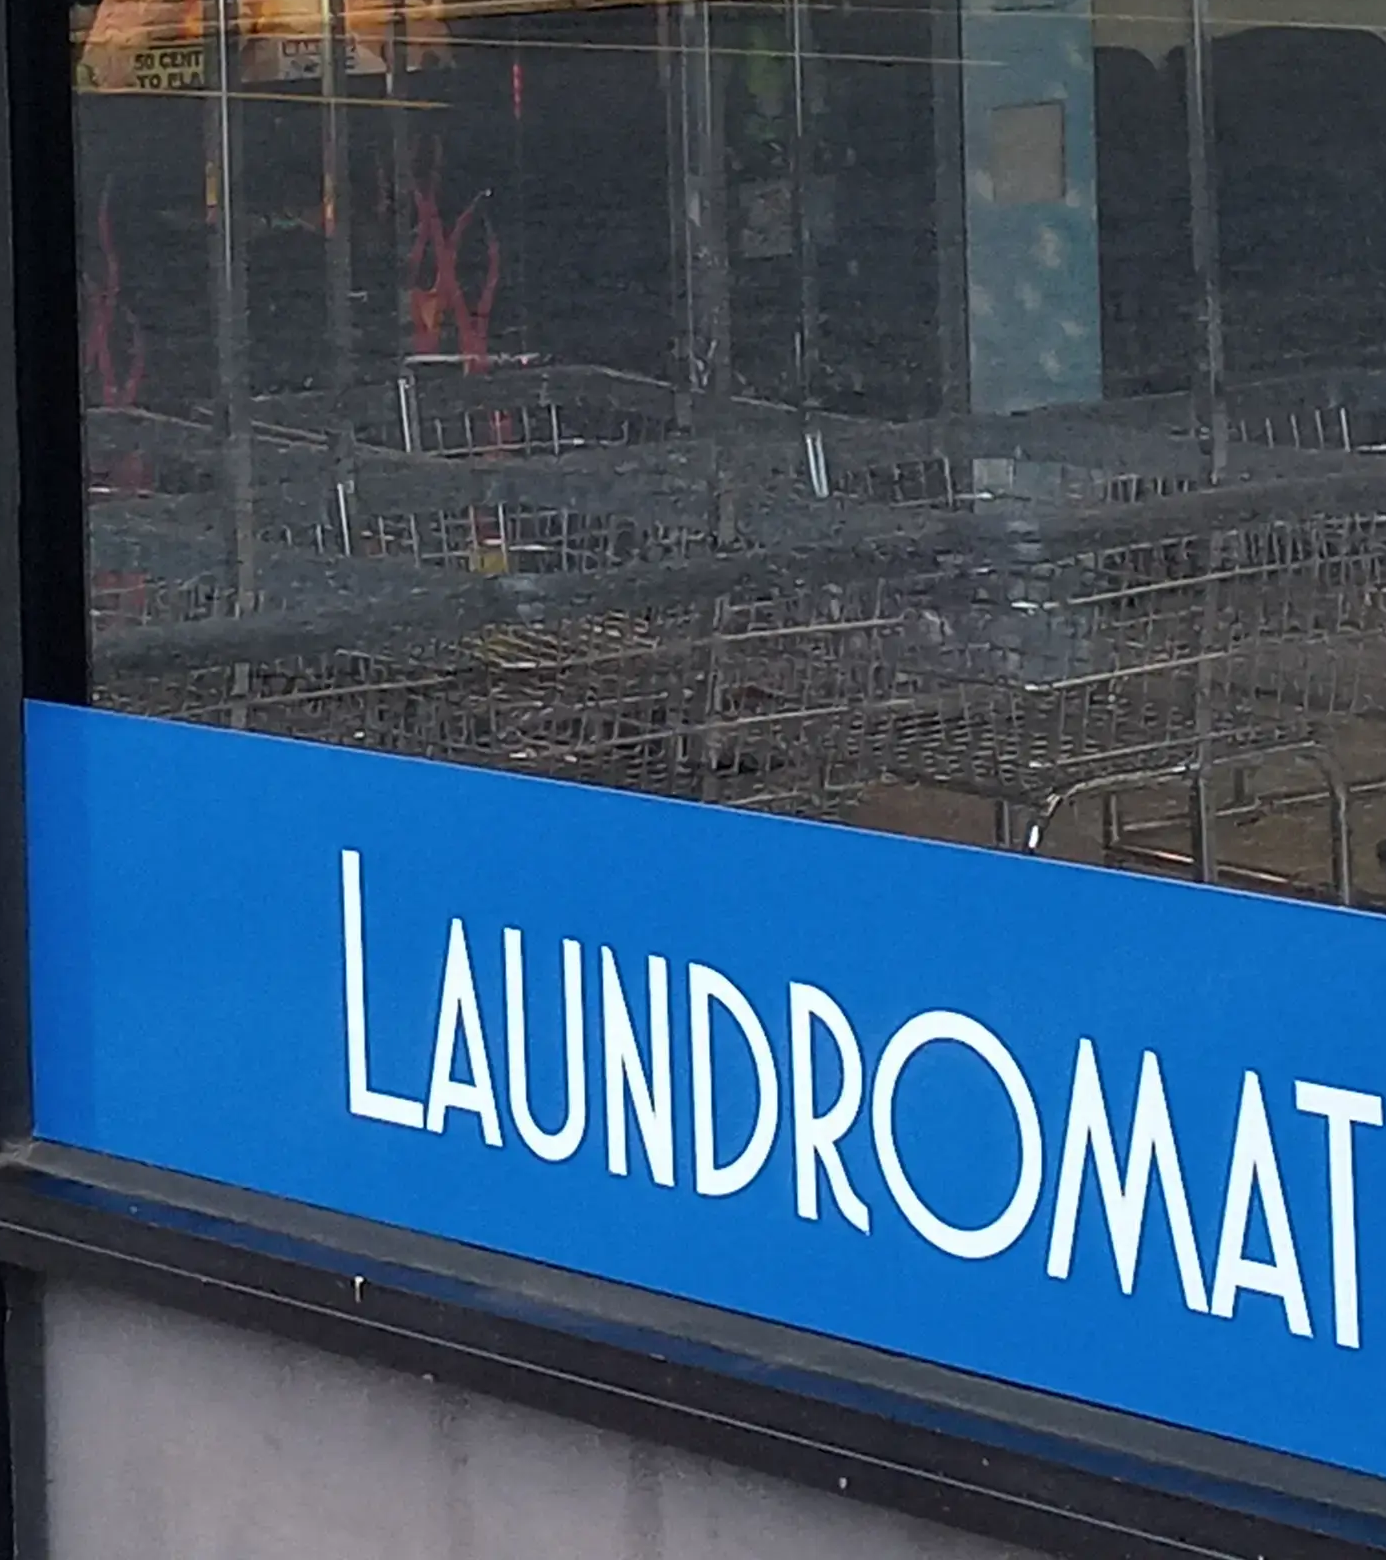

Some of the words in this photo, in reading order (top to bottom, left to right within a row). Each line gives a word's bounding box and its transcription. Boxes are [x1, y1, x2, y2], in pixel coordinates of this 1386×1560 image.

[133, 52, 156, 71] 50
[136, 73, 162, 89] TO
[340, 849, 1385, 1349] LAUNDROMAT
